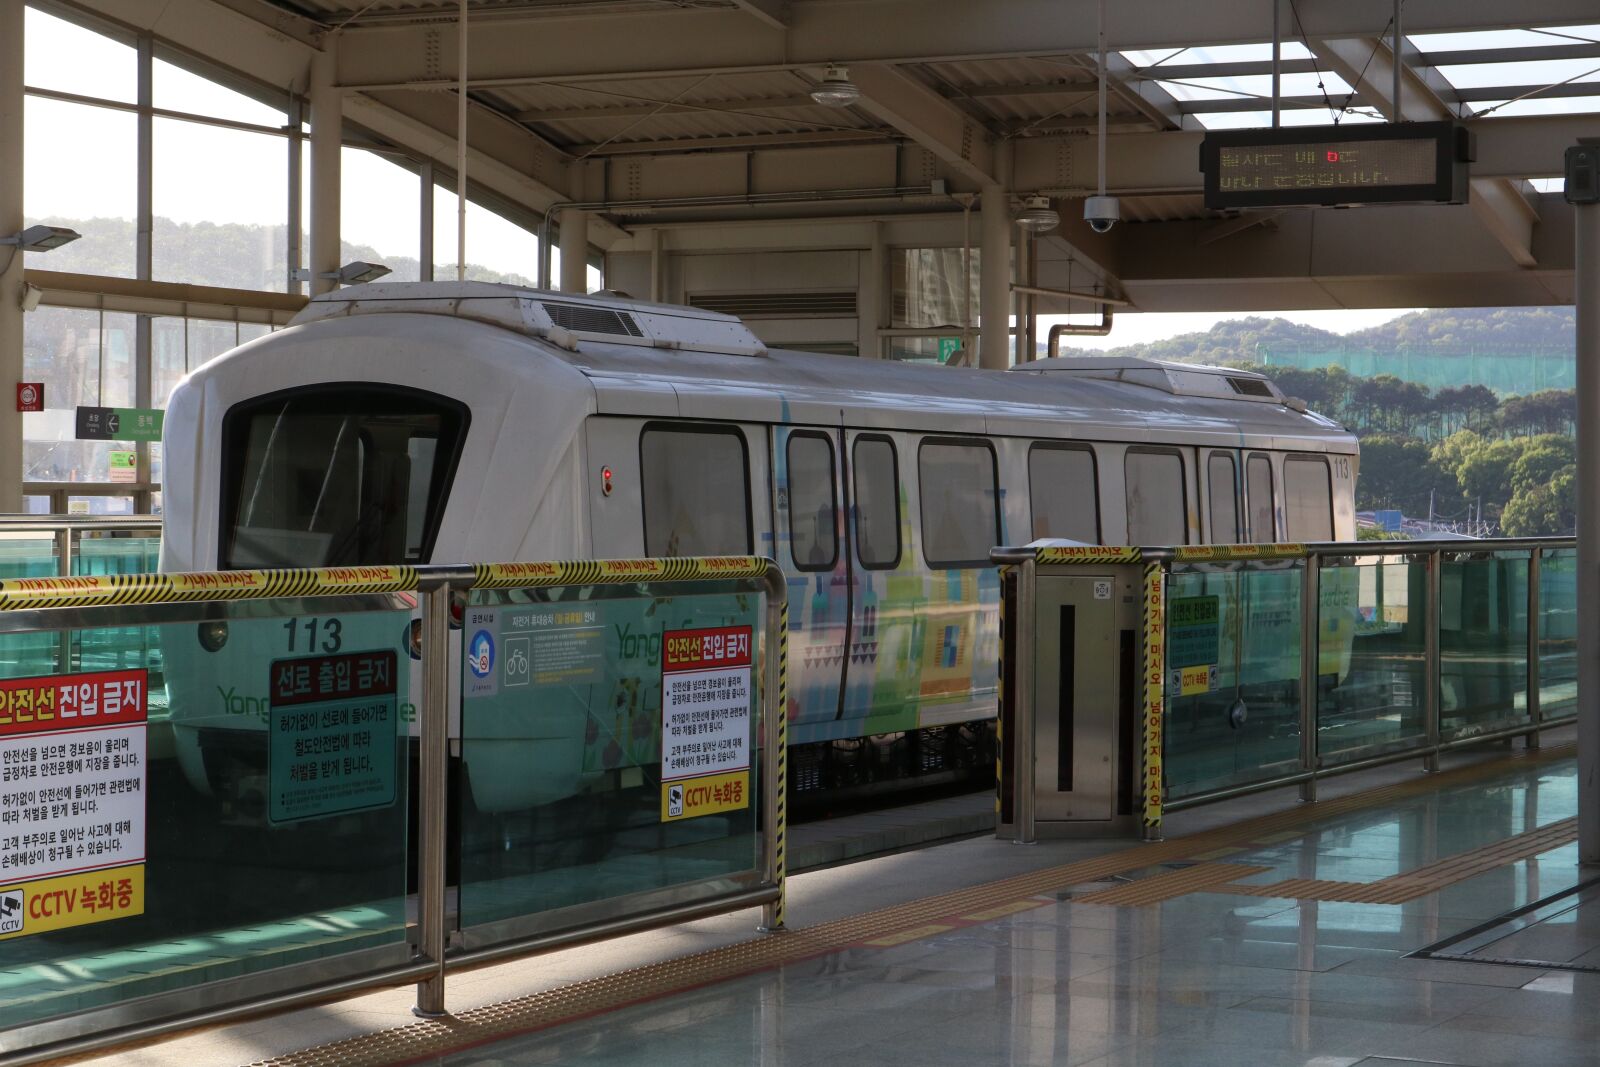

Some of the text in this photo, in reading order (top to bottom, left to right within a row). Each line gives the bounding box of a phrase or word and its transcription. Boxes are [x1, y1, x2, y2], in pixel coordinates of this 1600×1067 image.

[1335, 457, 1349, 479] 113
[283, 617, 342, 653] 113
[668, 633, 748, 663] 안전선 진입 금지
[278, 656, 390, 698] 선로 출입 금지
[672, 676, 742, 693] 안전선을 넘으면 경보음이 울리며
[0, 679, 141, 724] 안전선 진입 금지
[672, 693, 691, 706] 급정차로
[693, 690, 715, 703] 안전운행에
[717, 689, 731, 700] 지장을
[280, 711, 318, 733] 허가없이
[320, 708, 349, 729] 선로에
[352, 703, 388, 723] 들어가면
[672, 706, 748, 725] 허가없이 안전선에 들어가면 관련법에
[672, 726, 681, 736] 따라
[683, 723, 697, 735] 처벌을
[698, 722, 708, 733] 받게
[3, 737, 130, 765] 안전선을 넘으면 경보음이 울리며
[294, 731, 372, 758] 철도안전법에 따라
[671, 738, 742, 756] 고객 부주의로 일어난 사고에 대해
[3, 752, 140, 783] 급정차로 안전운행에 지장을 줍니다.
[290, 754, 374, 783] 처벌을 받게 됩니다.
[671, 756, 695, 769] 손해배상이
[695, 754, 710, 766] 청구될
[711, 753, 717, 763] 수
[2, 777, 141, 809] 허가없이 안전선에 들어가면 관련법에
[686, 780, 742, 808] CCTV 녹화중
[2, 799, 99, 826] 따라 처벌을 받게 됩니다.
[670, 807, 681, 815] CCTV
[2, 819, 131, 852] 고객 부주의로 일어난 사고에 대해
[2, 838, 122, 869] 손해배상이 청구될 수 있습니다.
[29, 879, 133, 920] CCTV 녹화중
[1, 920, 20, 932] CCTV
